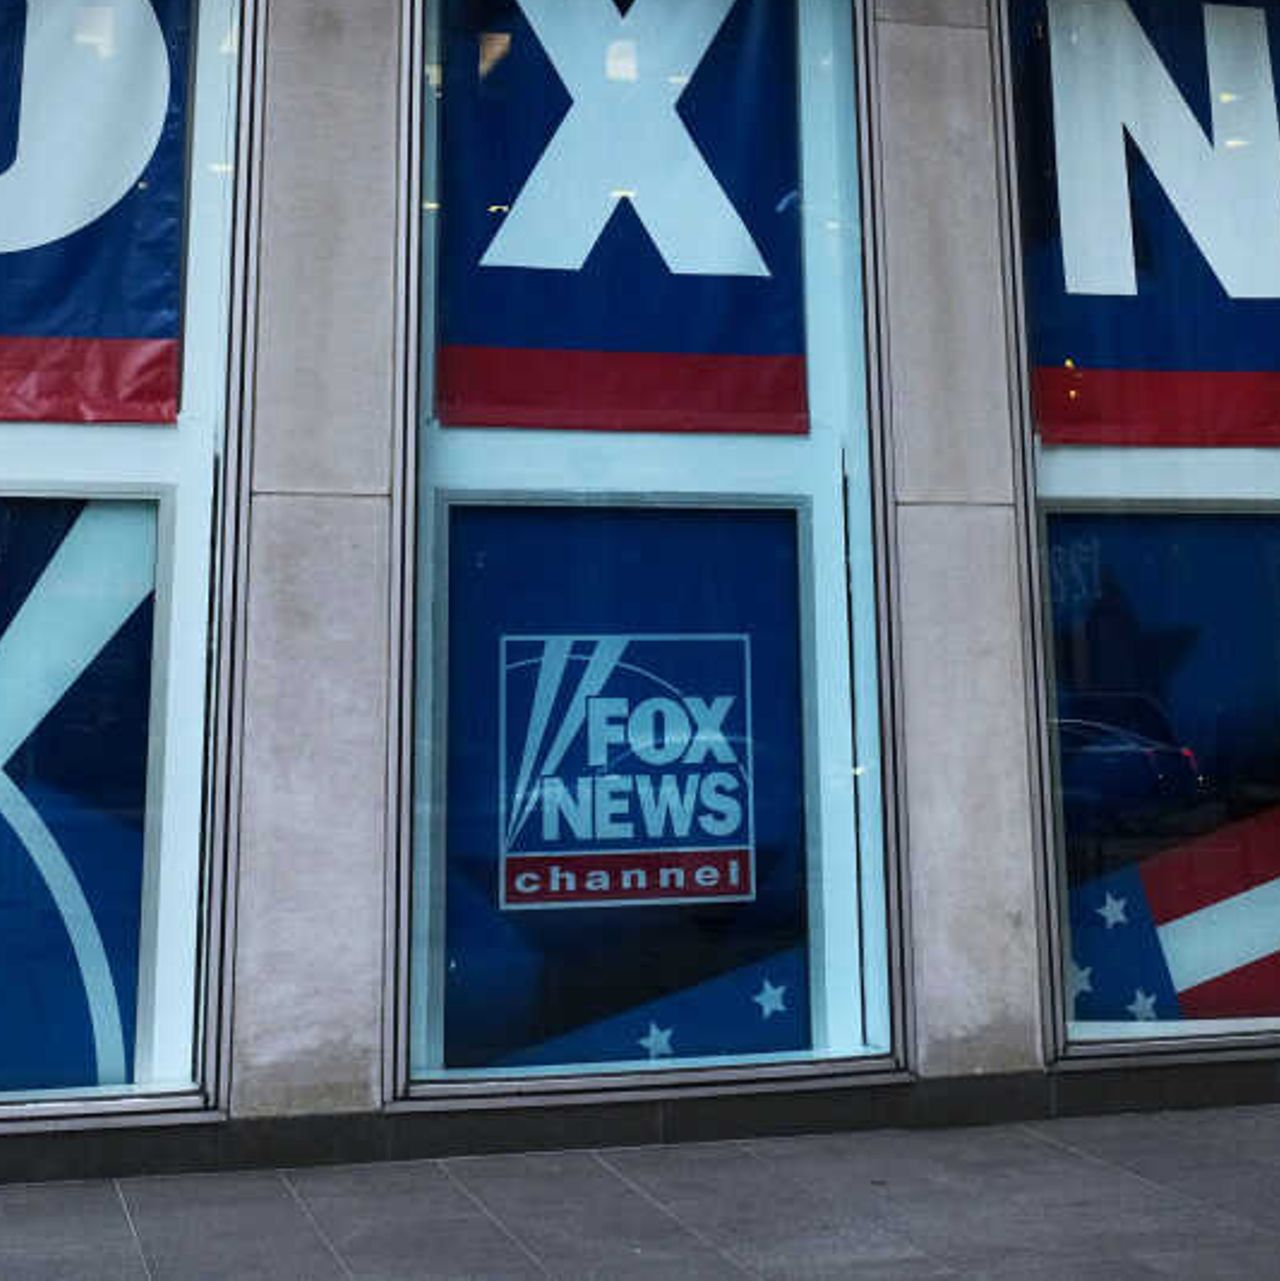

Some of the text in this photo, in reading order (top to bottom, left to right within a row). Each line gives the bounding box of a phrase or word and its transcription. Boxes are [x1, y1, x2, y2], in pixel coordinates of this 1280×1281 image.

[587, 695, 737, 767] FOX
[539, 771, 743, 841] NEWS
[513, 859, 742, 895] channel
